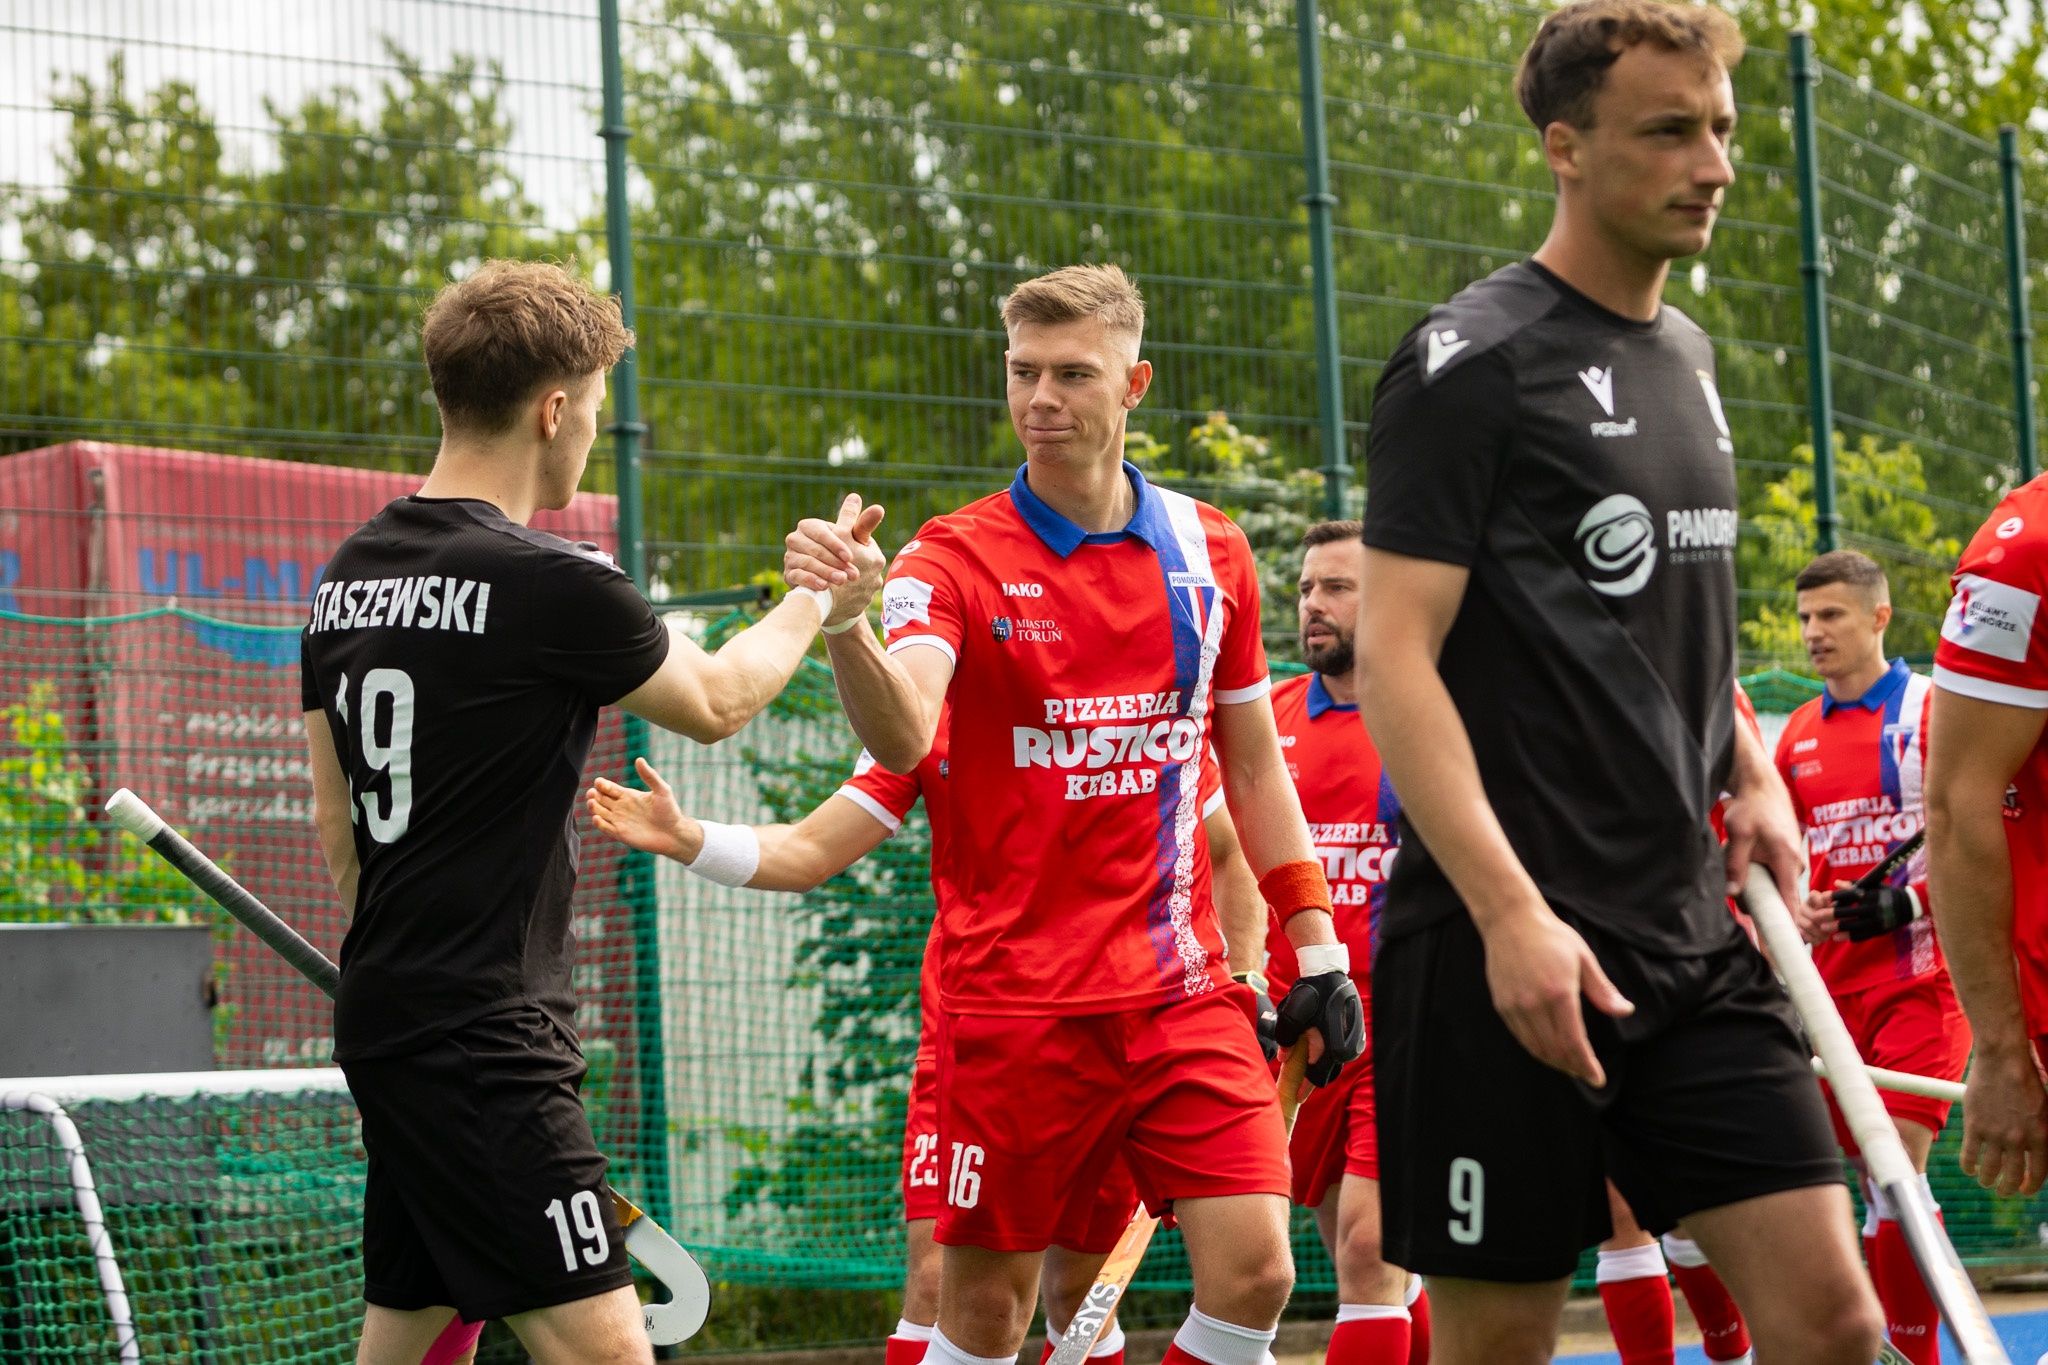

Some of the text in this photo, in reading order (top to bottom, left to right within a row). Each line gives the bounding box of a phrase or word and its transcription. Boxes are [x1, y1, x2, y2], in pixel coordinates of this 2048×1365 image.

[309, 575, 491, 635] STASZEWSKI
[1015, 618, 1056, 630] MIASTO
[1016, 626, 1063, 643] TORUŃ
[1043, 691, 1182, 724] PIZZERIA
[1013, 718, 1199, 769] RUSTICO
[1064, 768, 1158, 801] KEBAB
[1812, 795, 1896, 825] PIZZERIA
[1309, 822, 1389, 844] ZZERIA
[909, 1133, 939, 1188] 23
[947, 1141, 985, 1210] 16
[1447, 1156, 1485, 1246] 9
[543, 1190, 610, 1272] 19
